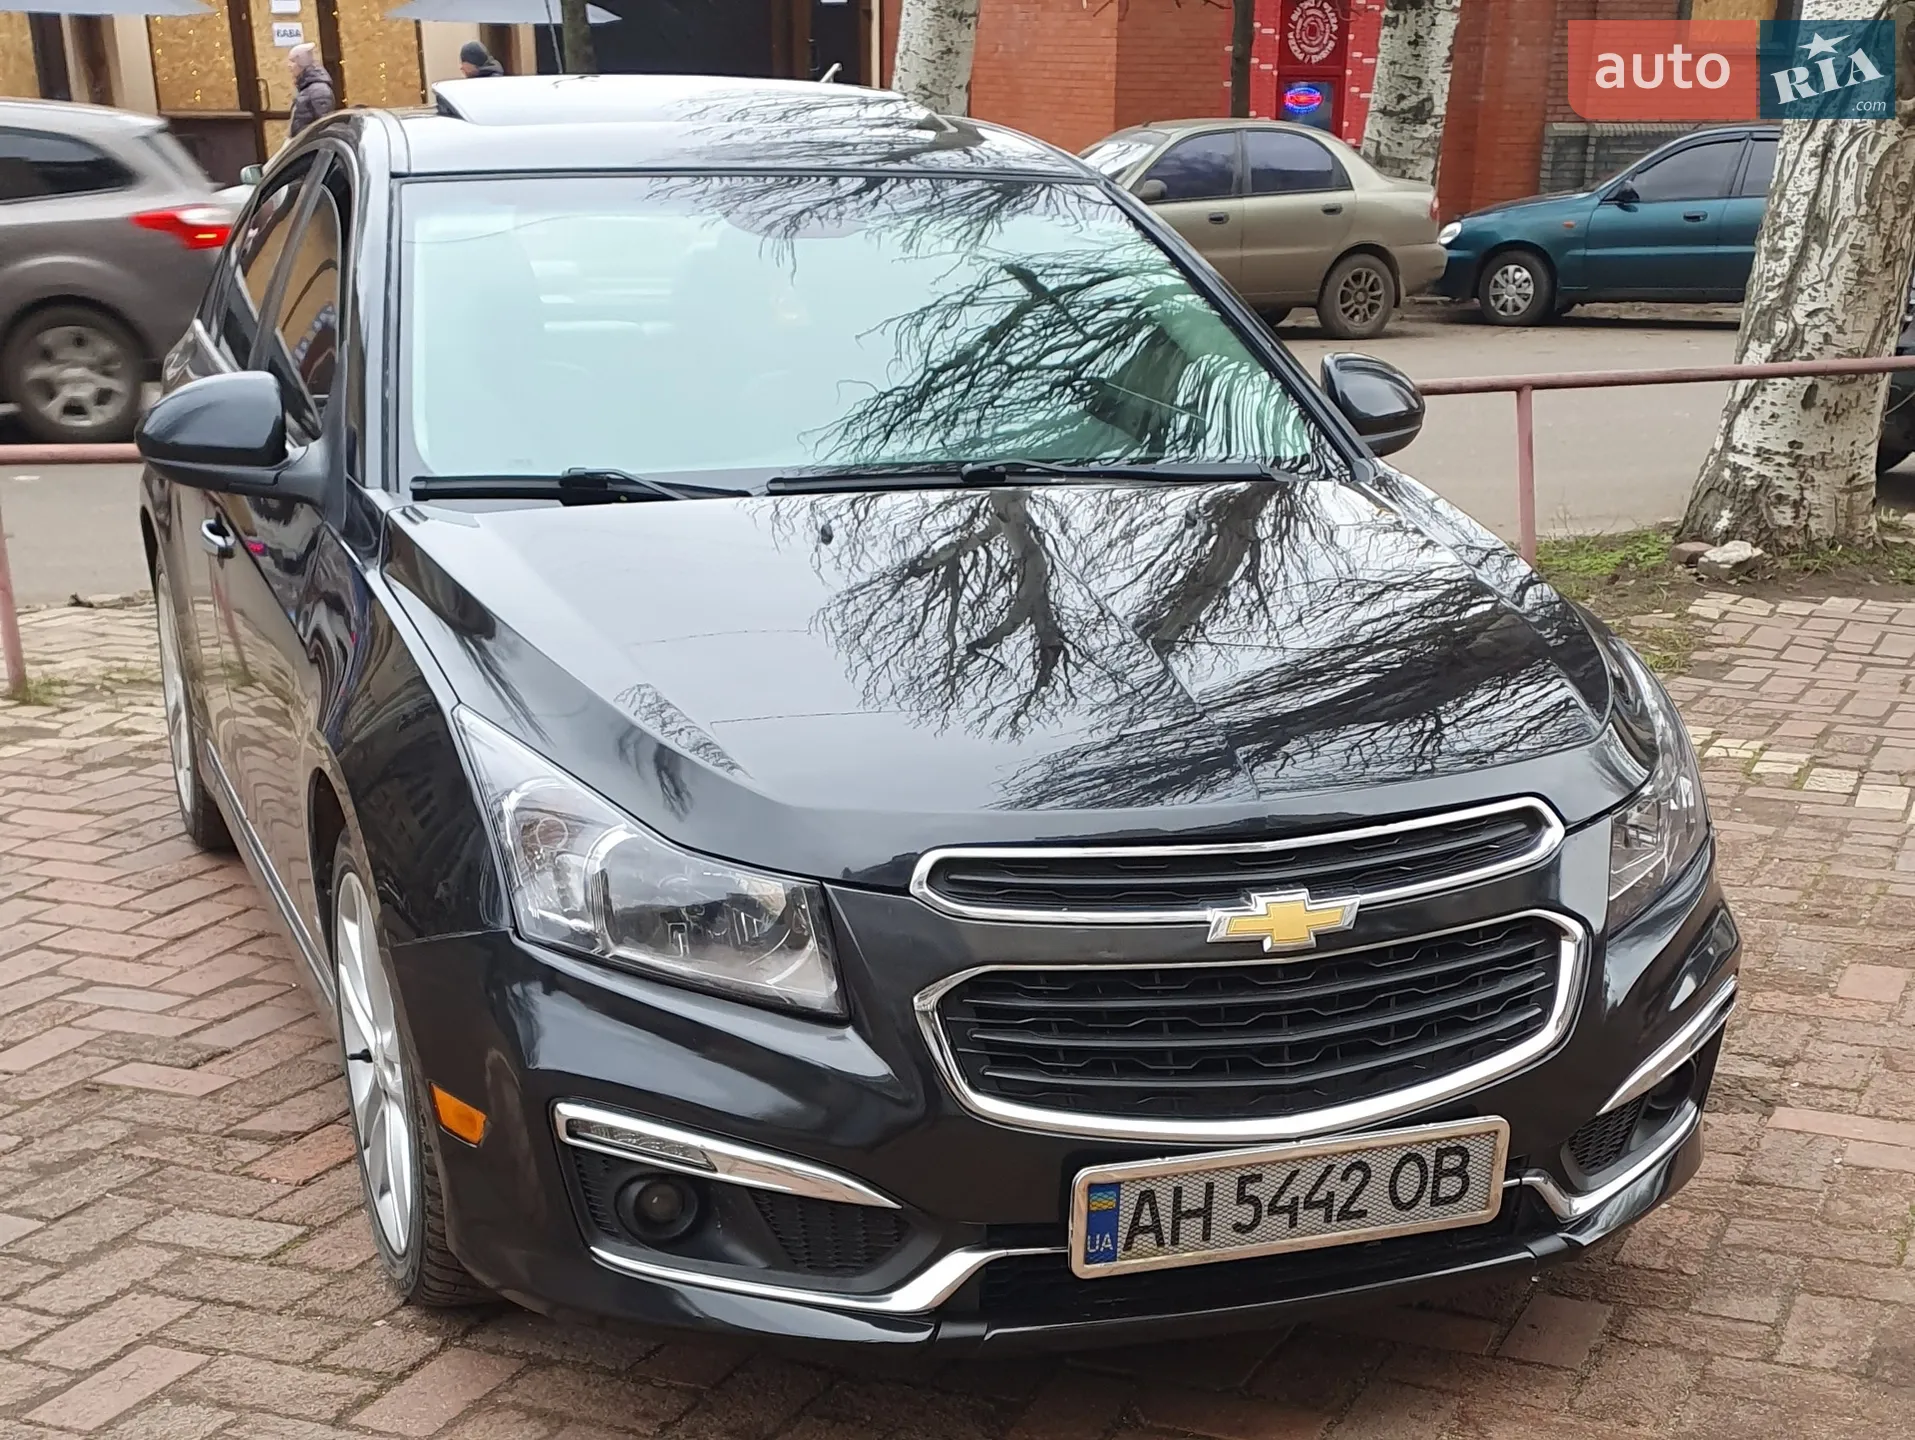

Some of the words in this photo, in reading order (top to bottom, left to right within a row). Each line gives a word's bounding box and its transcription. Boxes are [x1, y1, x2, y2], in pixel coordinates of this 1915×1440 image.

[1124, 1183, 1215, 1252] AH
[1231, 1161, 1372, 1235] 5442
[1388, 1146, 1471, 1212] OB
[1086, 1232, 1114, 1254] UA
